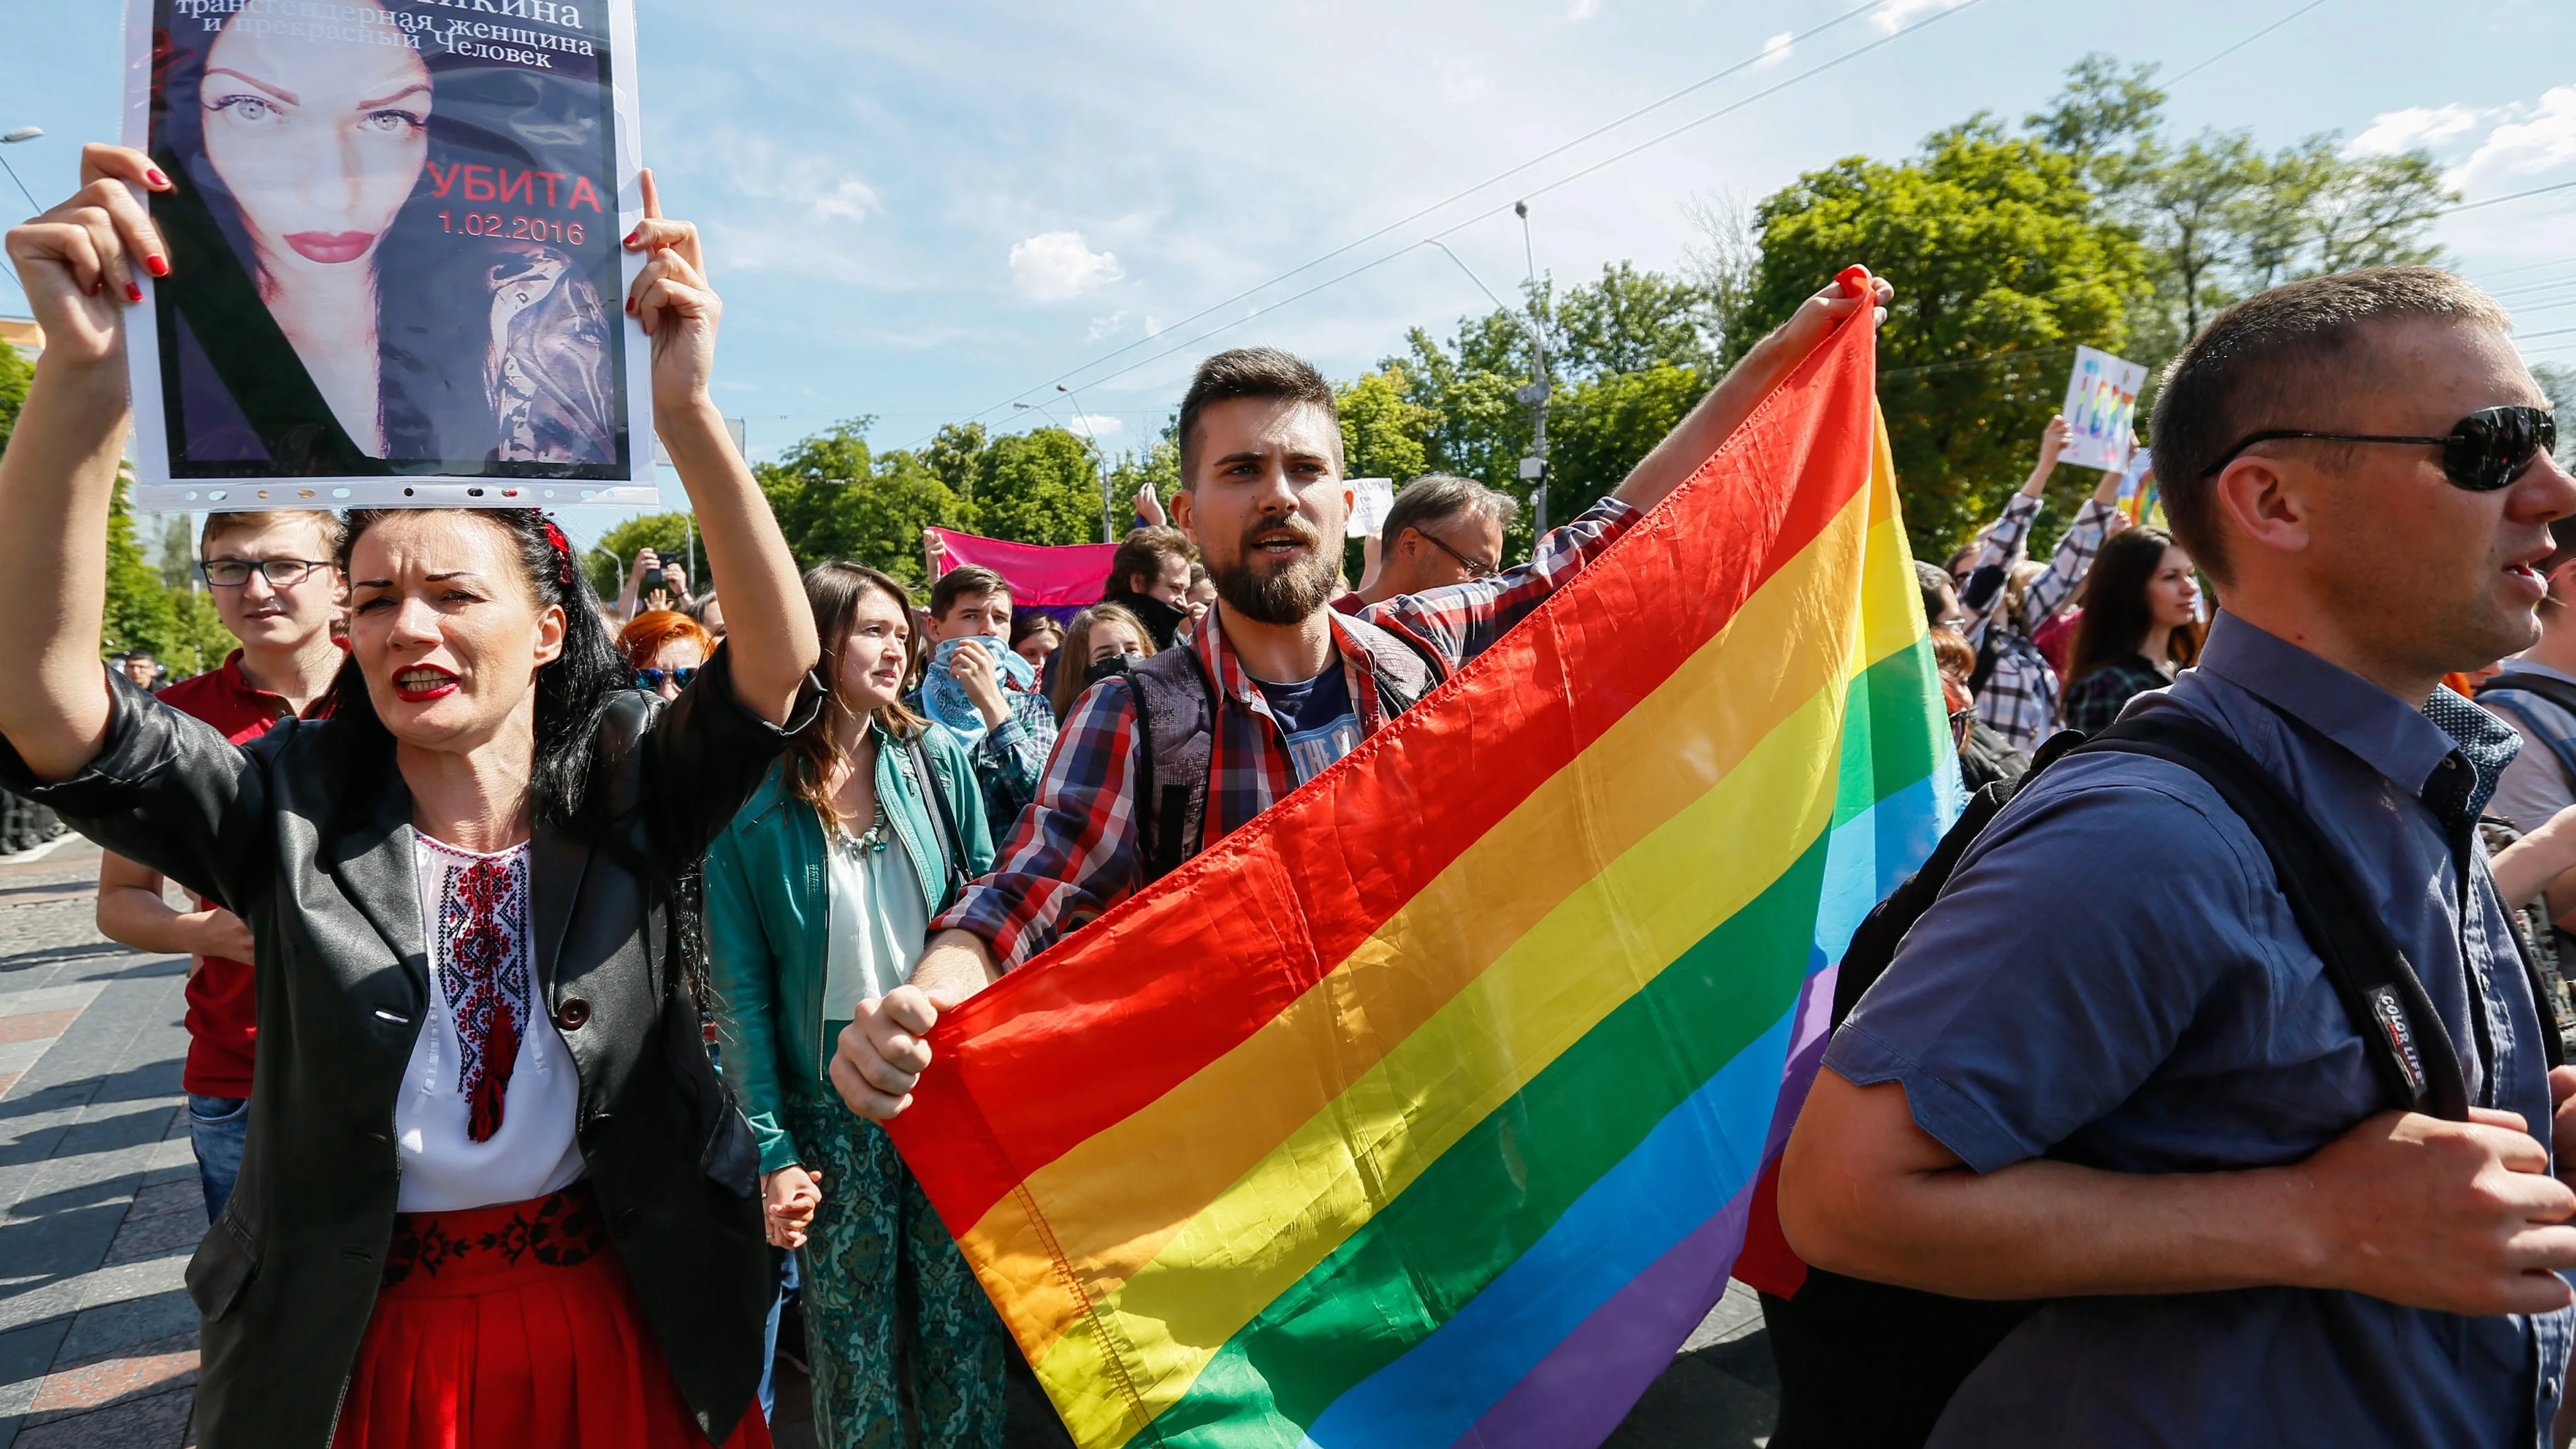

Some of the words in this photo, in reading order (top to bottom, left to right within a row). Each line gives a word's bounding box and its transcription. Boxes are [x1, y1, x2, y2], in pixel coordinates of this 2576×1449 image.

[175, 0, 434, 31] трансгендерная
[446, 18, 594, 57] женщина
[203, 18, 223, 31] и
[234, 18, 422, 50] прекрасный
[435, 30, 553, 69] Человек
[425, 159, 602, 213] УБИТА
[438, 210, 586, 245] 1.02.2016
[1290, 738, 1331, 782] THE
[2382, 995, 2409, 1044] COLOR
[2404, 1046, 2423, 1080] LIFE
